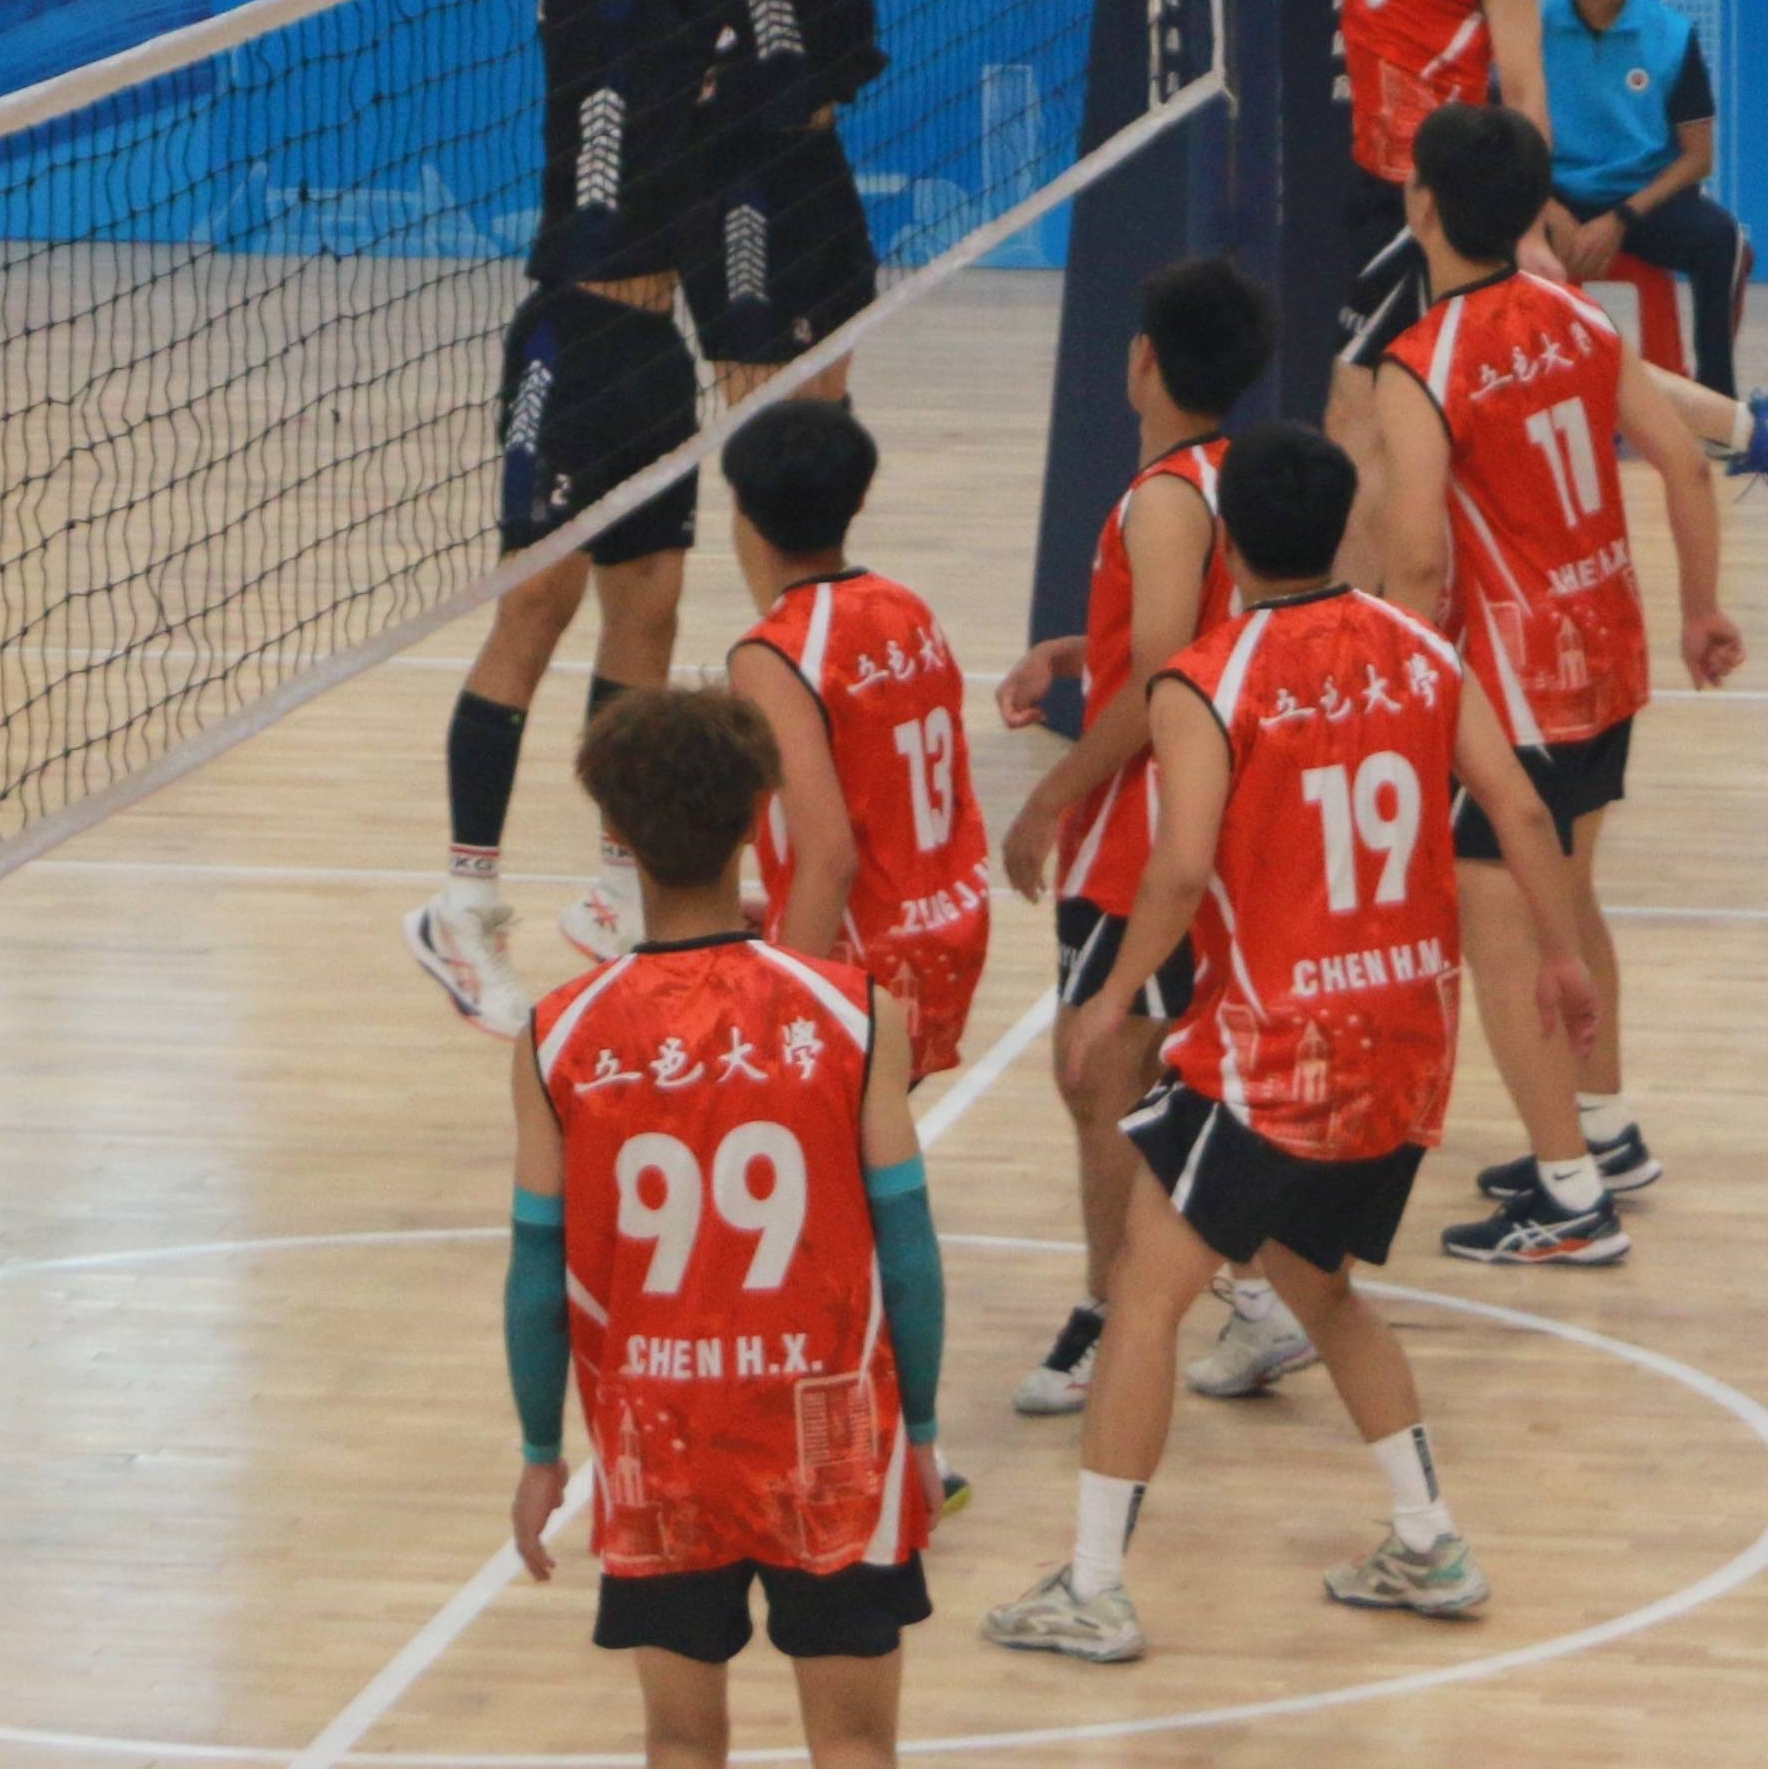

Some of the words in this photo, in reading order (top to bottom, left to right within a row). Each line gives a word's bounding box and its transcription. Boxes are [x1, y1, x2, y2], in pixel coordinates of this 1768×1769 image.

[1525, 395, 1602, 530] 11
[894, 705, 953, 852] 13
[1302, 750, 1423, 914] 19
[1292, 948, 1389, 998] CHEN
[615, 1120, 808, 1294] 99
[625, 1333, 723, 1380] CHEN
